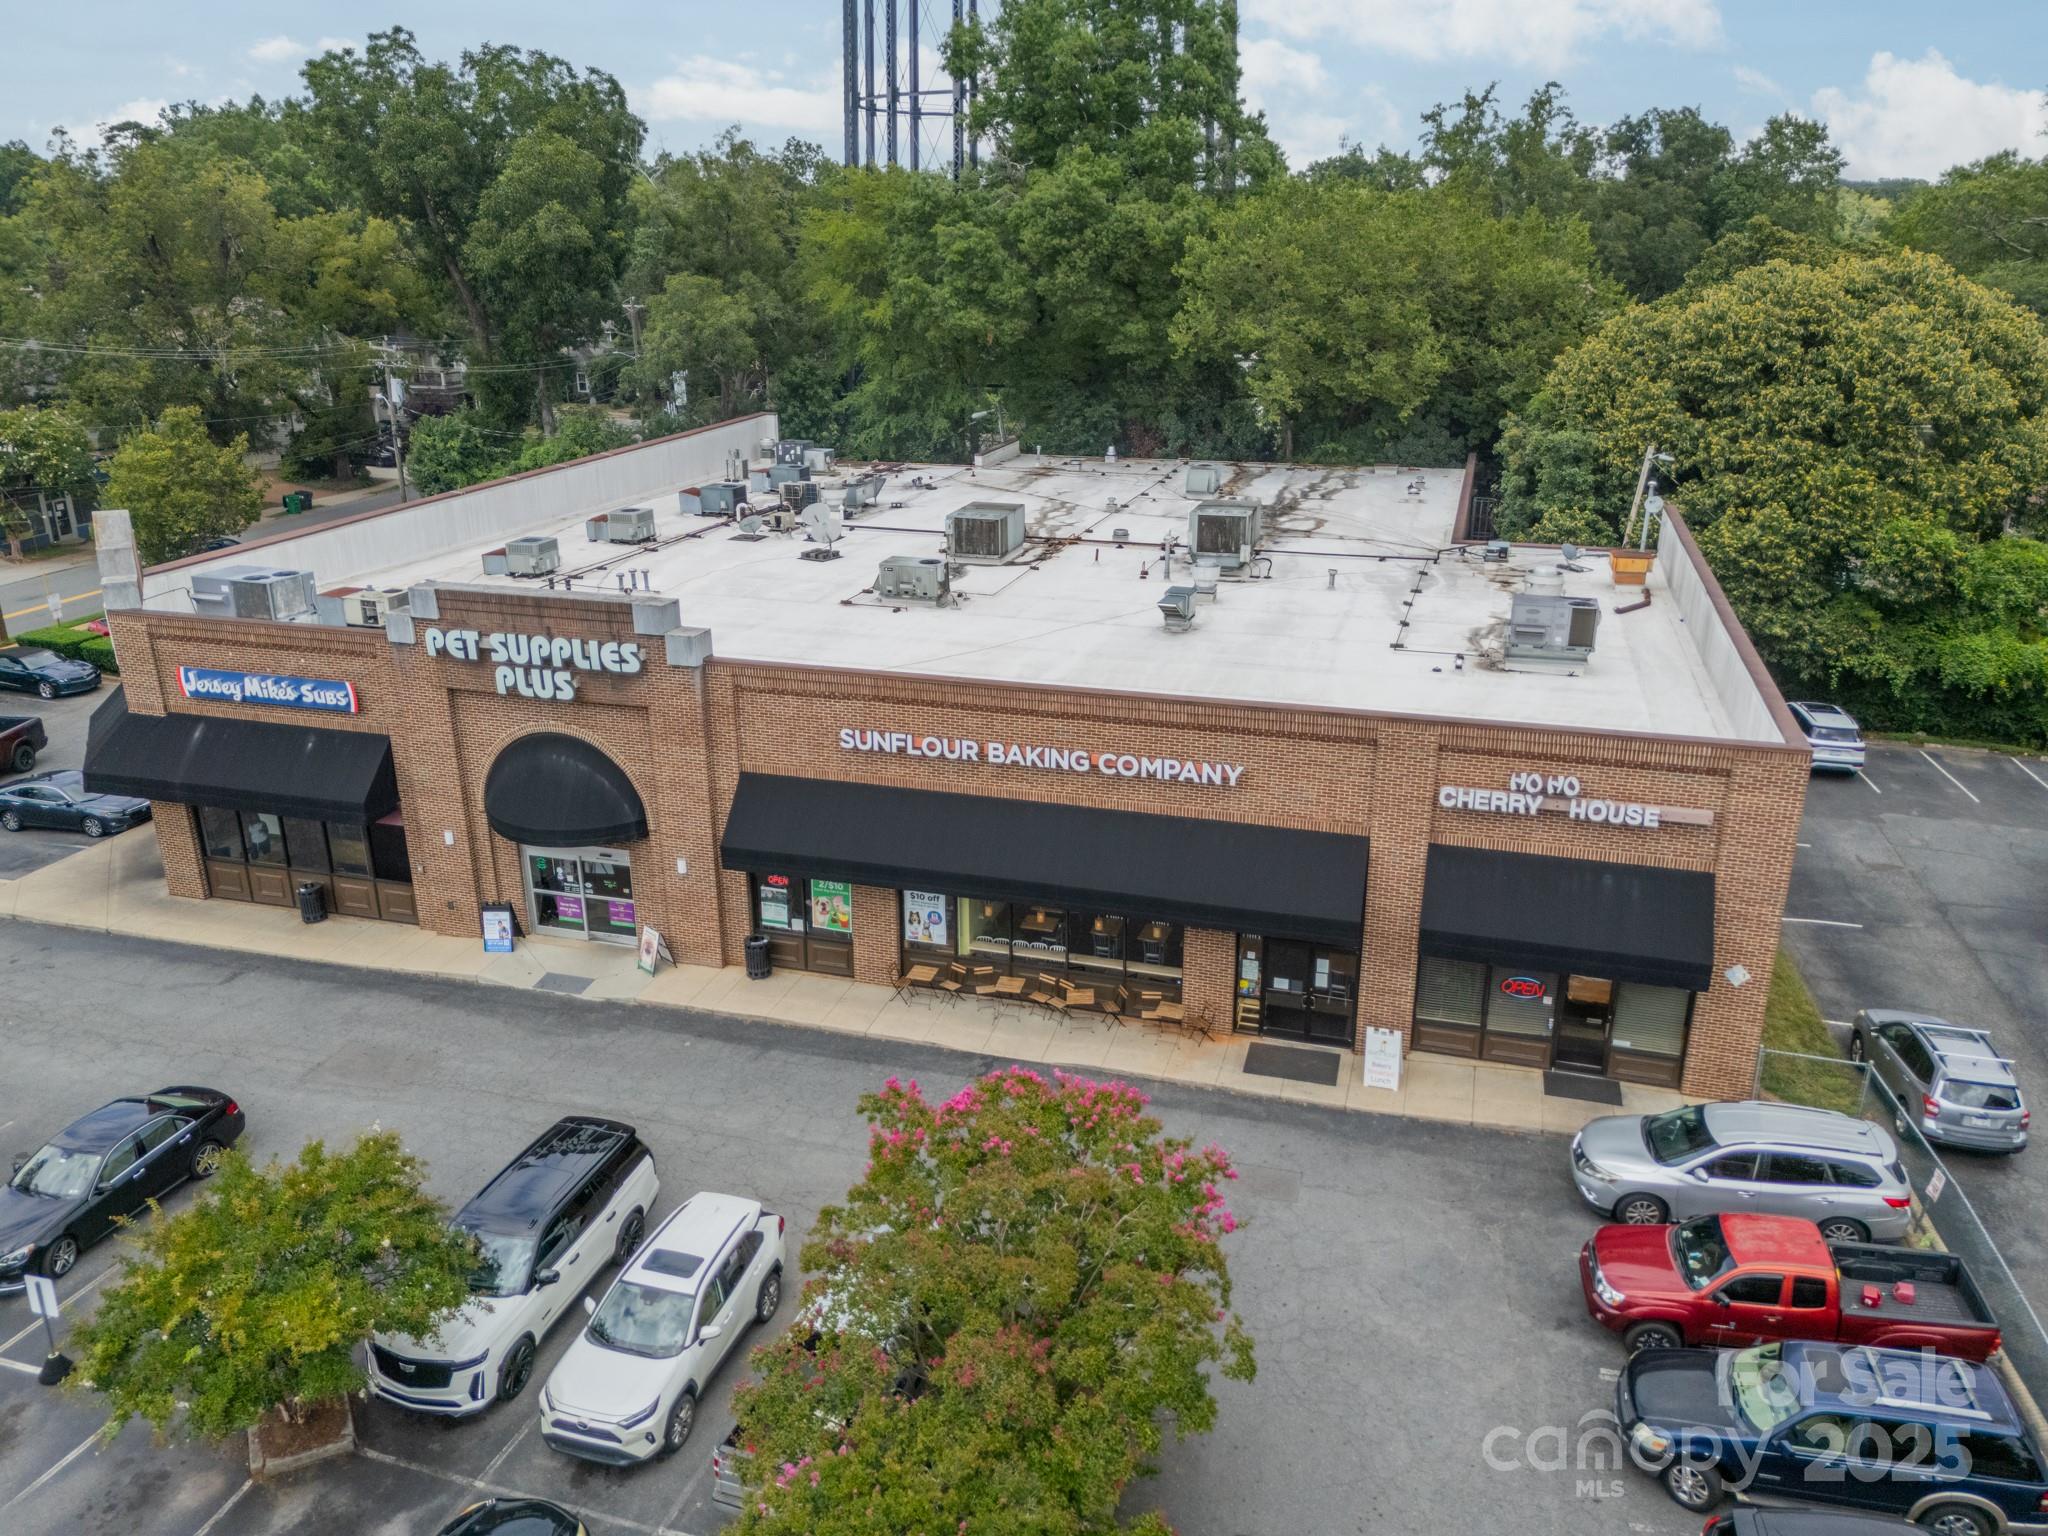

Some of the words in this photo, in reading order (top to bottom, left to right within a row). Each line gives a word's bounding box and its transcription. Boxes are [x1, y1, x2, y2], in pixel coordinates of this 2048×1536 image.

[425, 627, 479, 660] PET
[488, 632, 641, 673] SUPPLIES
[185, 670, 242, 701] Jersey
[243, 676, 300, 701] Mike's
[495, 665, 575, 700] PLUS
[839, 728, 980, 761] SUNFLOUR
[987, 742, 1090, 772] BAKING
[1098, 753, 1244, 786] COMPANY
[1509, 772, 1543, 793] HO
[1546, 775, 1580, 796] HO
[1438, 786, 1544, 815] CHERRY
[1568, 799, 1661, 828] HOUSE
[767, 875, 790, 886] OPEN
[910, 891, 925, 901] $10
[1500, 979, 1547, 998] OPEN
